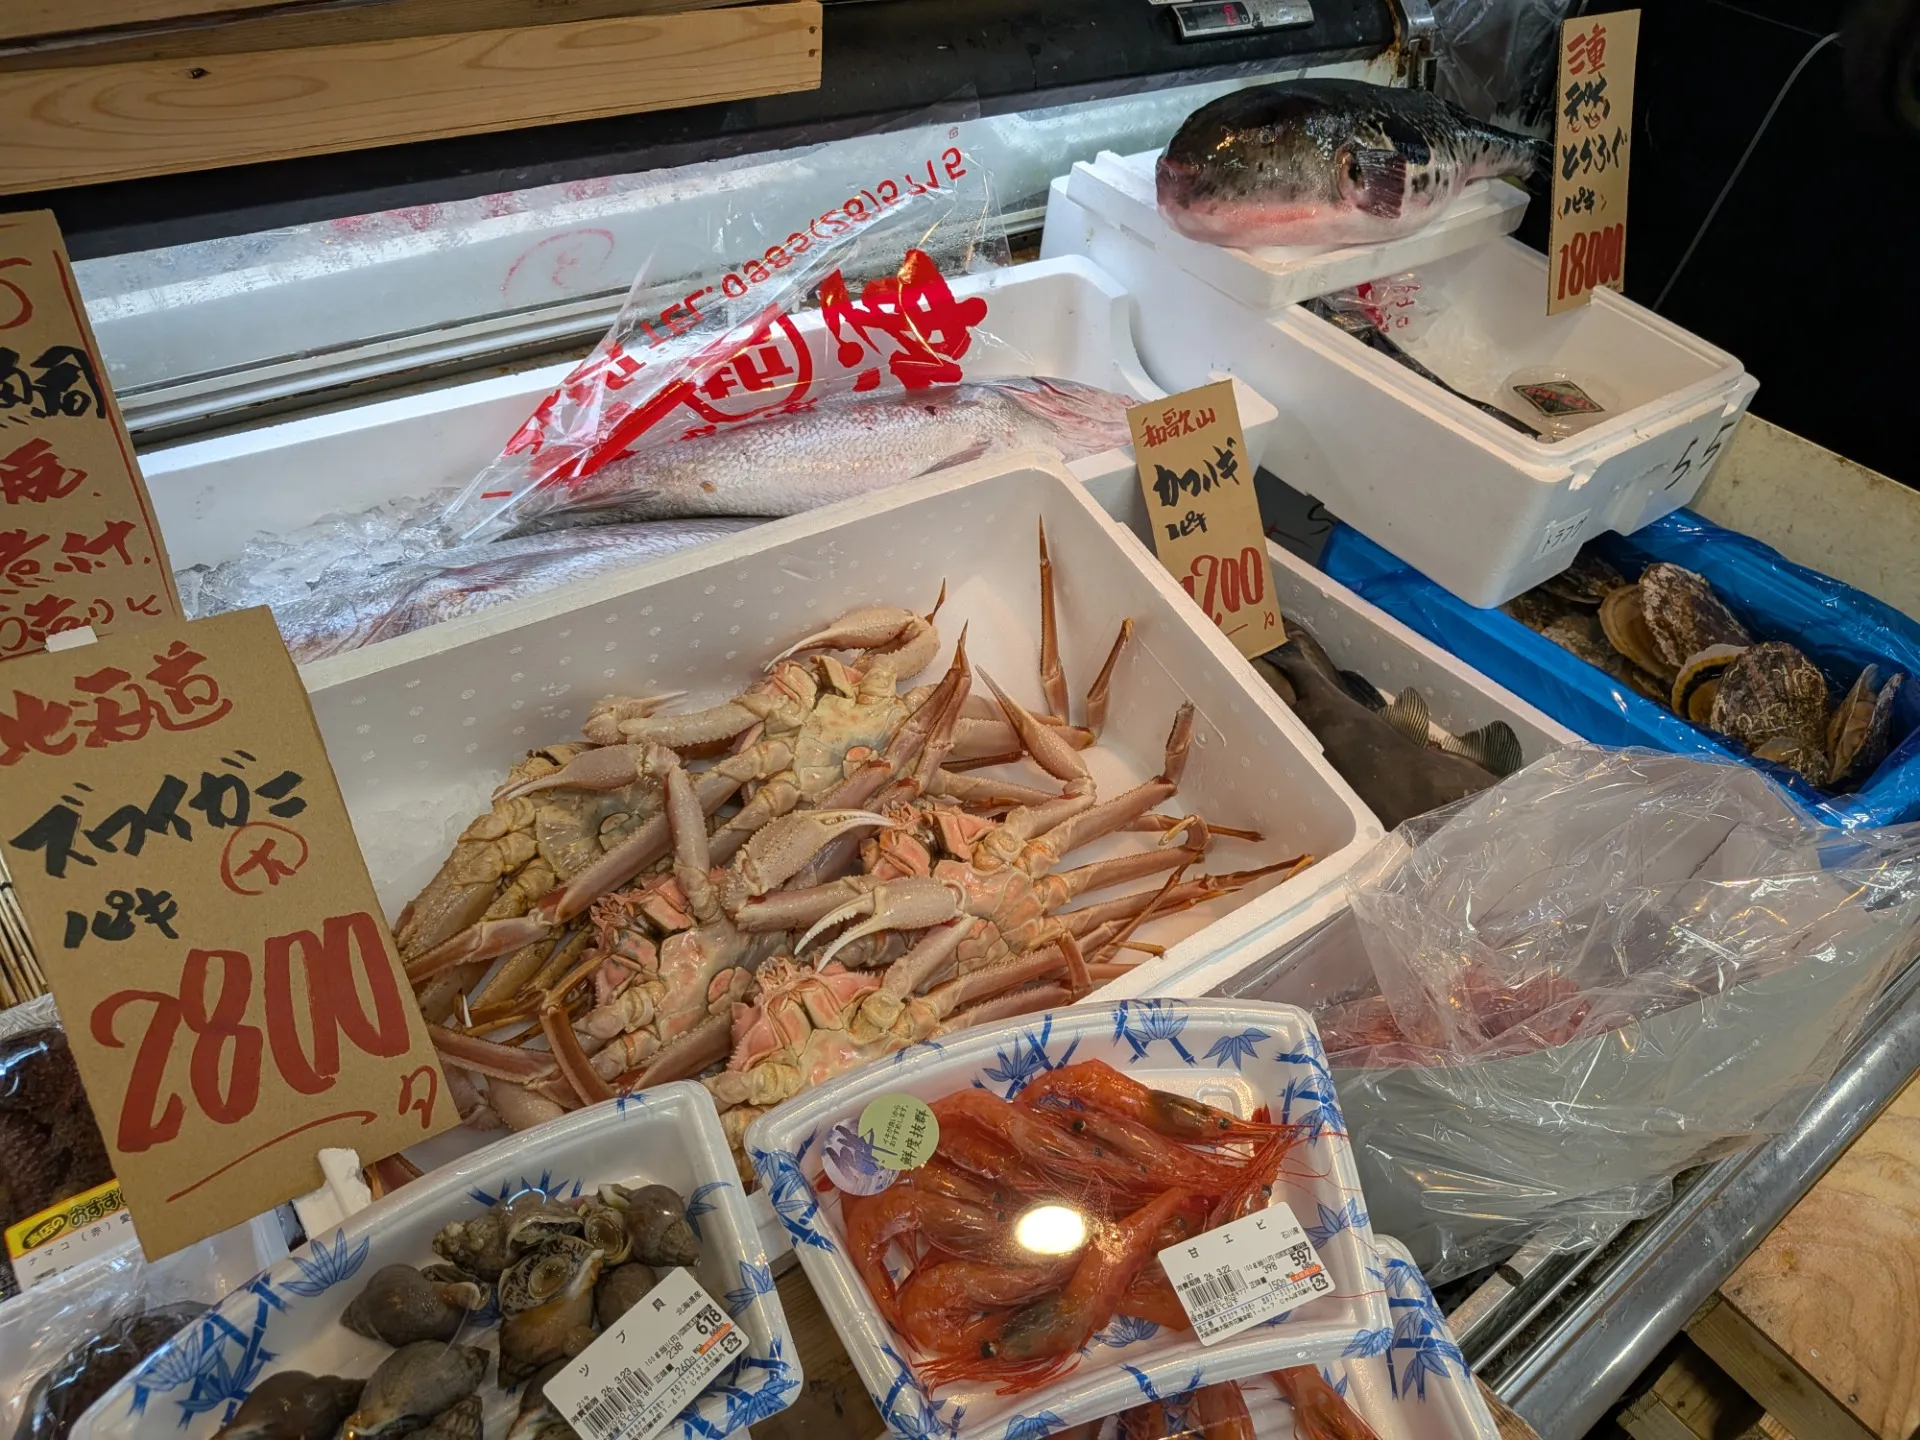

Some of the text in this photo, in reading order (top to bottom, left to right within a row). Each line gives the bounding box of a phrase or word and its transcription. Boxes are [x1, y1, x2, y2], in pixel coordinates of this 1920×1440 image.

[1566, 22, 1607, 76] 三重
[1557, 223, 1623, 301] 18000
[1140, 408, 1216, 448] 和歌山
[8, 750, 308, 879] ズワイガニ
[90, 911, 410, 1153] 2800
[900, 1108, 931, 1168] 鮮度抜群
[1262, 1261, 1278, 1274] 398
[1290, 1246, 1312, 1267] 597
[695, 1308, 722, 1335] 618
[665, 1341, 684, 1360] 238
